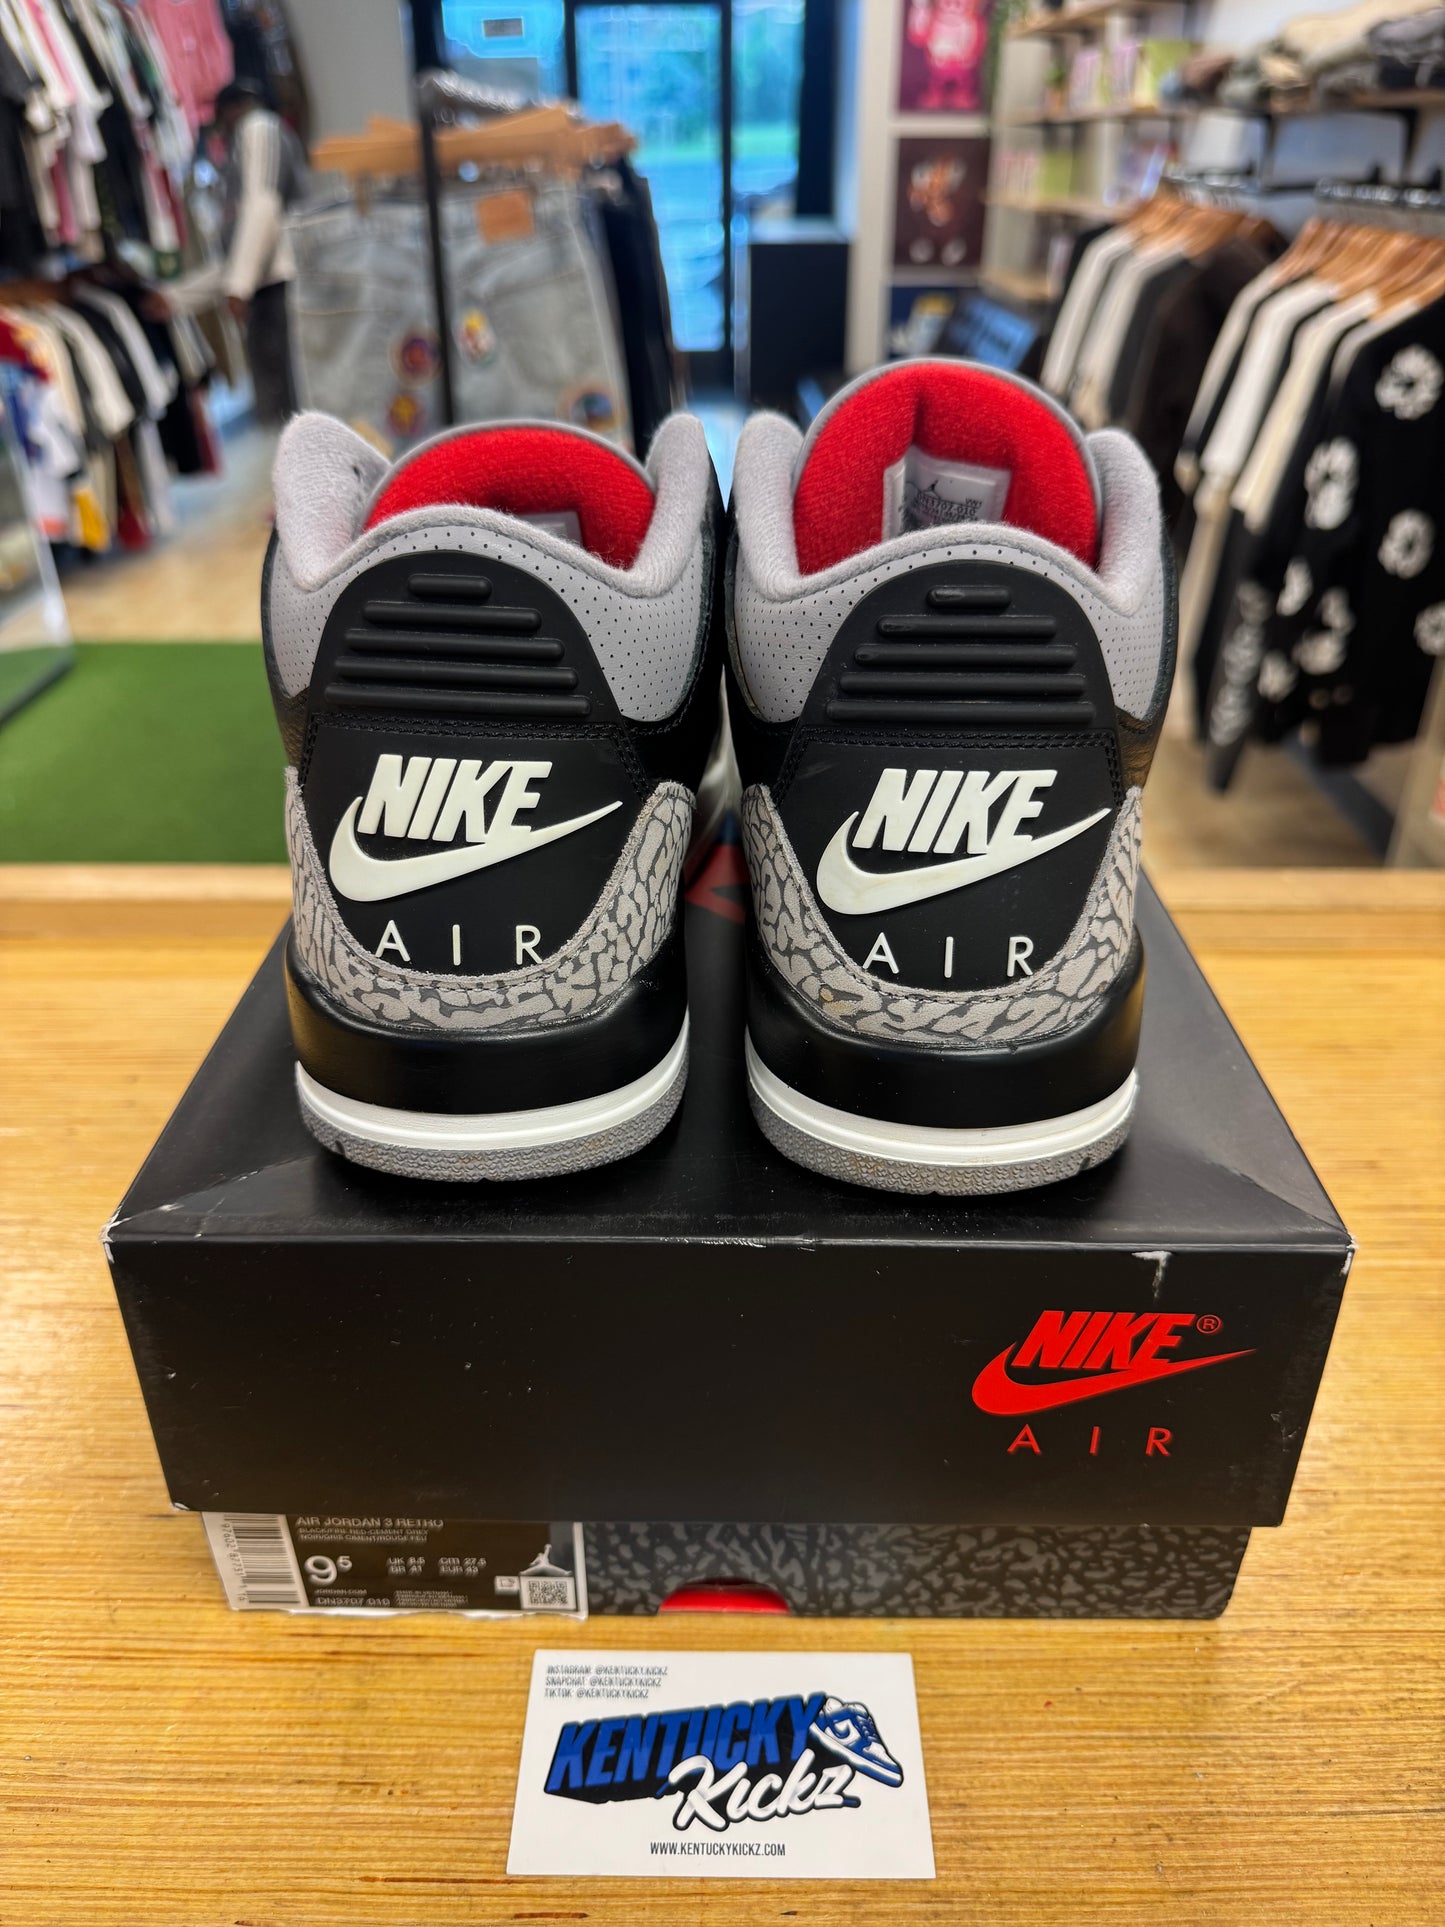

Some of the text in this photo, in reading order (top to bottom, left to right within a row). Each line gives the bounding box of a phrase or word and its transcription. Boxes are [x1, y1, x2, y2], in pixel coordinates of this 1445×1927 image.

[357, 753, 553, 844] NIKE
[852, 768, 1058, 855] NIKE
[375, 920, 543, 966] AIR
[862, 932, 1035, 979] AIR
[1011, 1310, 1197, 1370] NIKE
[1006, 1423, 1173, 1457] AIR
[296, 1516, 444, 1531] AIR JORDAN 3 RETRO
[408, 1565, 423, 1575] 41
[545, 1693, 826, 1793] KENTUCKY
[649, 1841, 787, 1857] WWW.KENTUCKYKICKZ.COM
